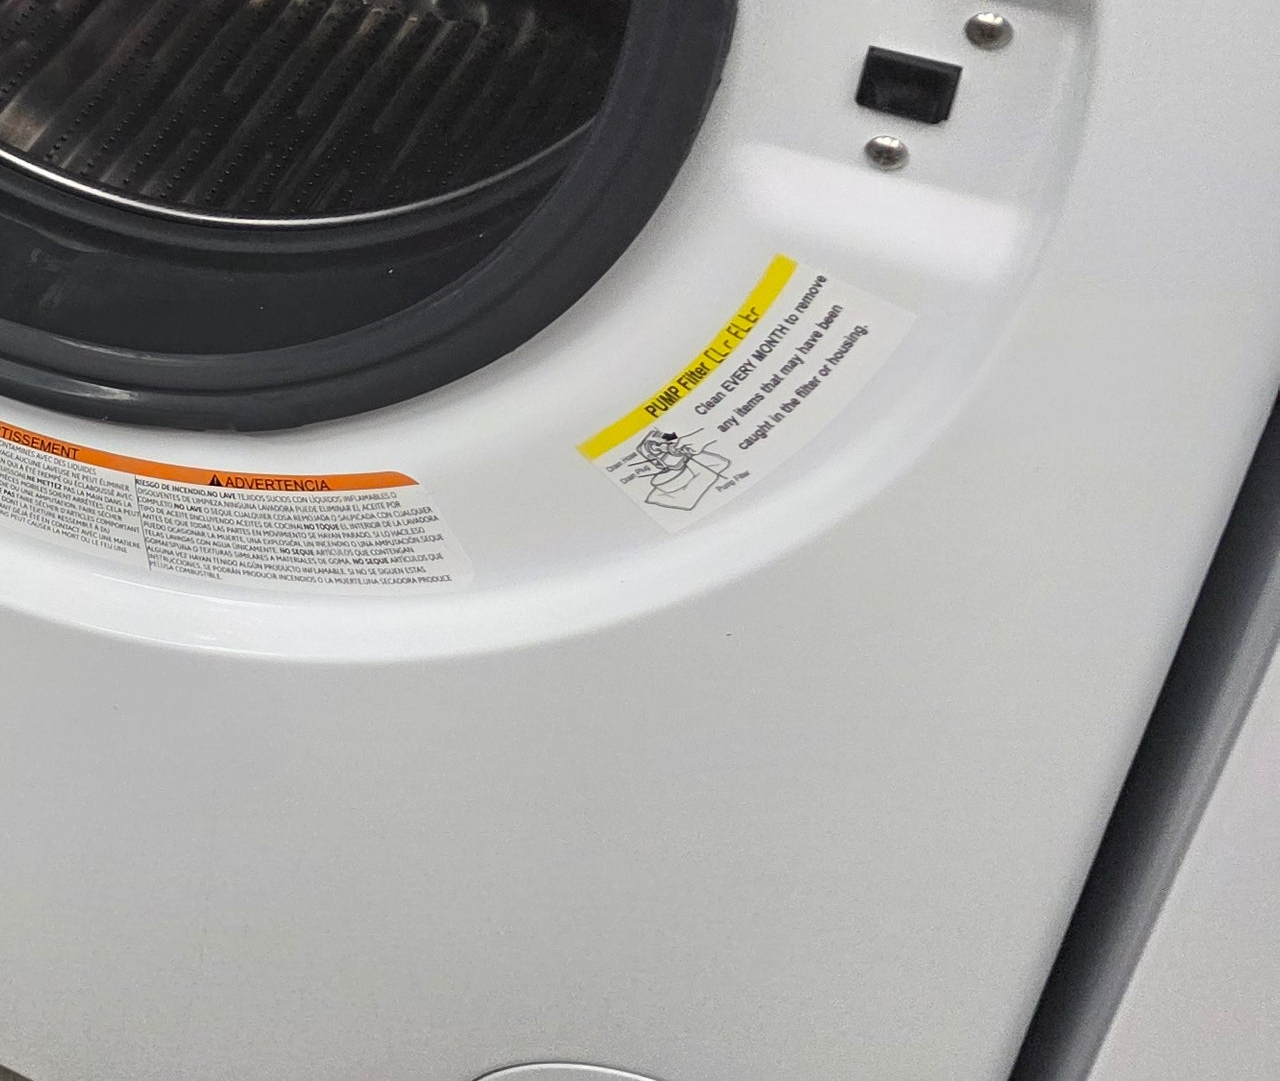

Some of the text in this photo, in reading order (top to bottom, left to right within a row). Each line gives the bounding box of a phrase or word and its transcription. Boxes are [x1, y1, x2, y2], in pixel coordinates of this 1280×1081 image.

[644, 386, 685, 418] PUMP
[676, 361, 711, 392] Filter
[694, 275, 828, 416] Clean EVERY MONTH to remove
[717, 304, 844, 433] any items that may have been
[738, 324, 868, 451] caught in the filter or housing.
[225, 476, 331, 492] ADVERTENCIA
